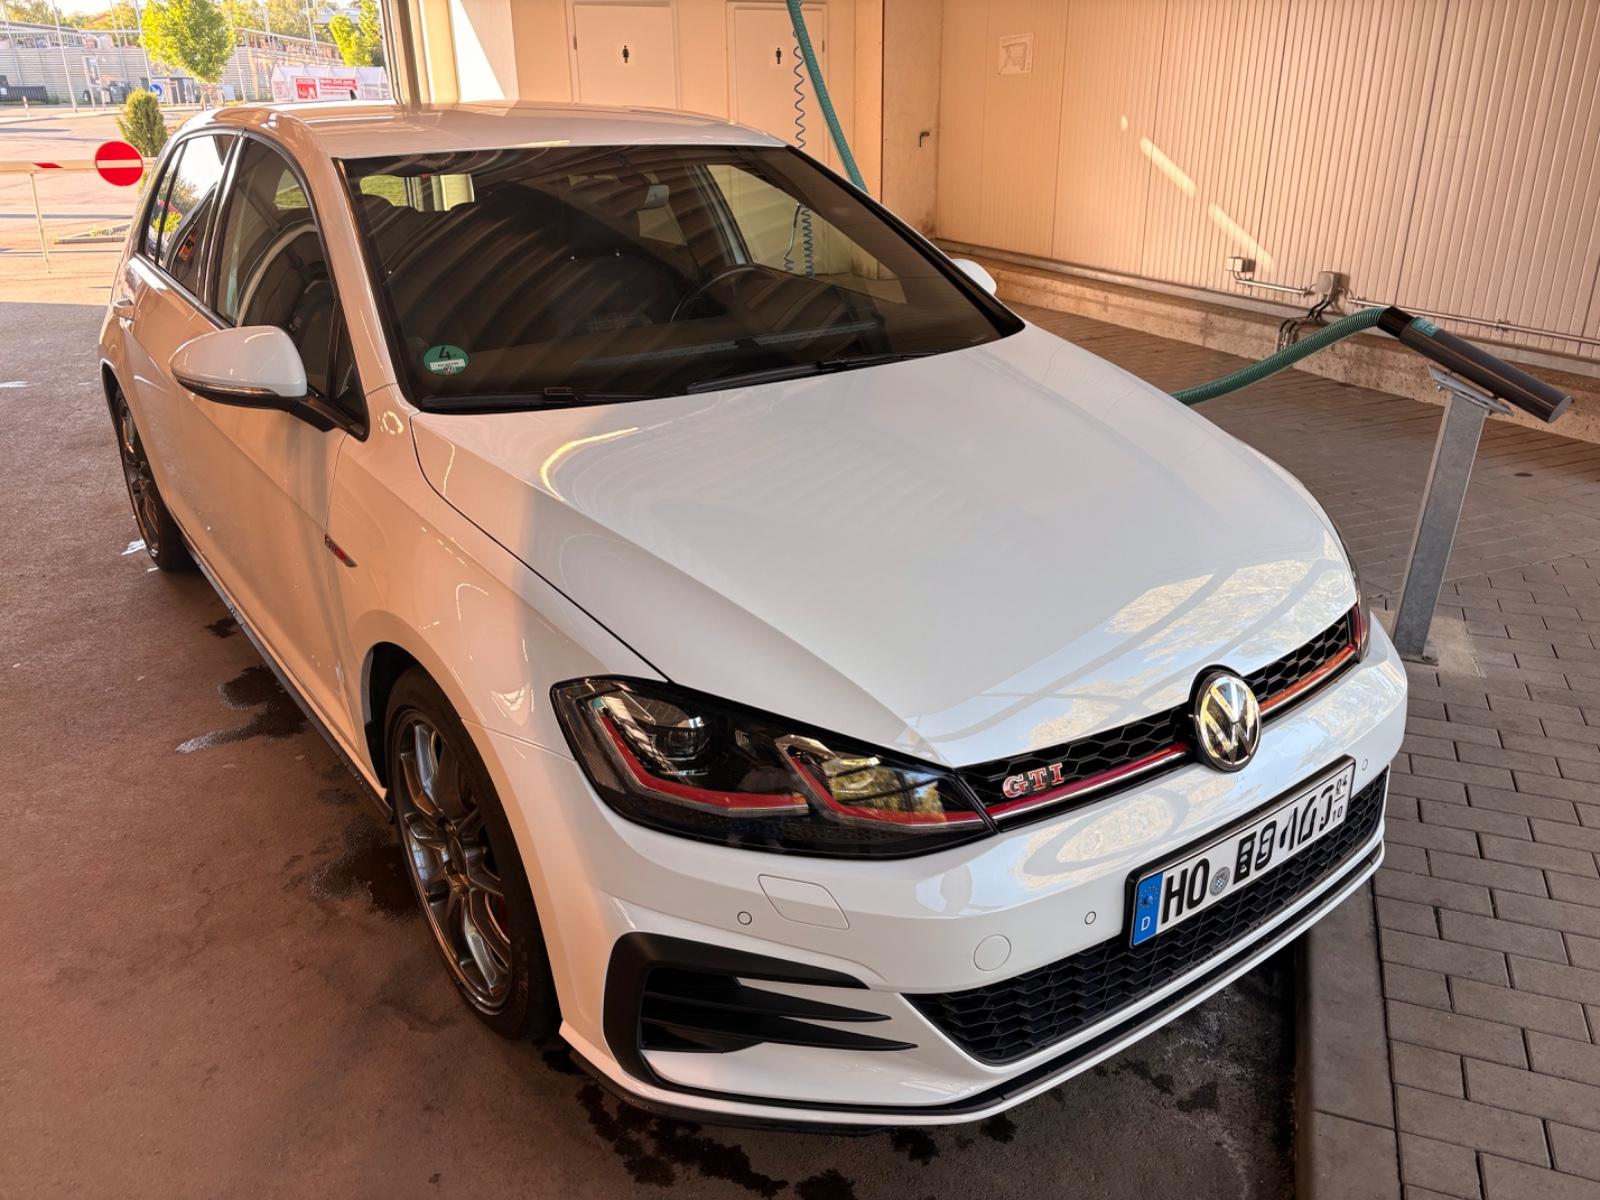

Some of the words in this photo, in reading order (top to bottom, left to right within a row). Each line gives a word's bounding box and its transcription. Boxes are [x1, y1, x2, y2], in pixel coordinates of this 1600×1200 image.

[1200, 677, 1259, 765] VW
[1003, 762, 1065, 798] GTI
[1162, 858, 1210, 924] HO
[1141, 916, 1151, 932] D
